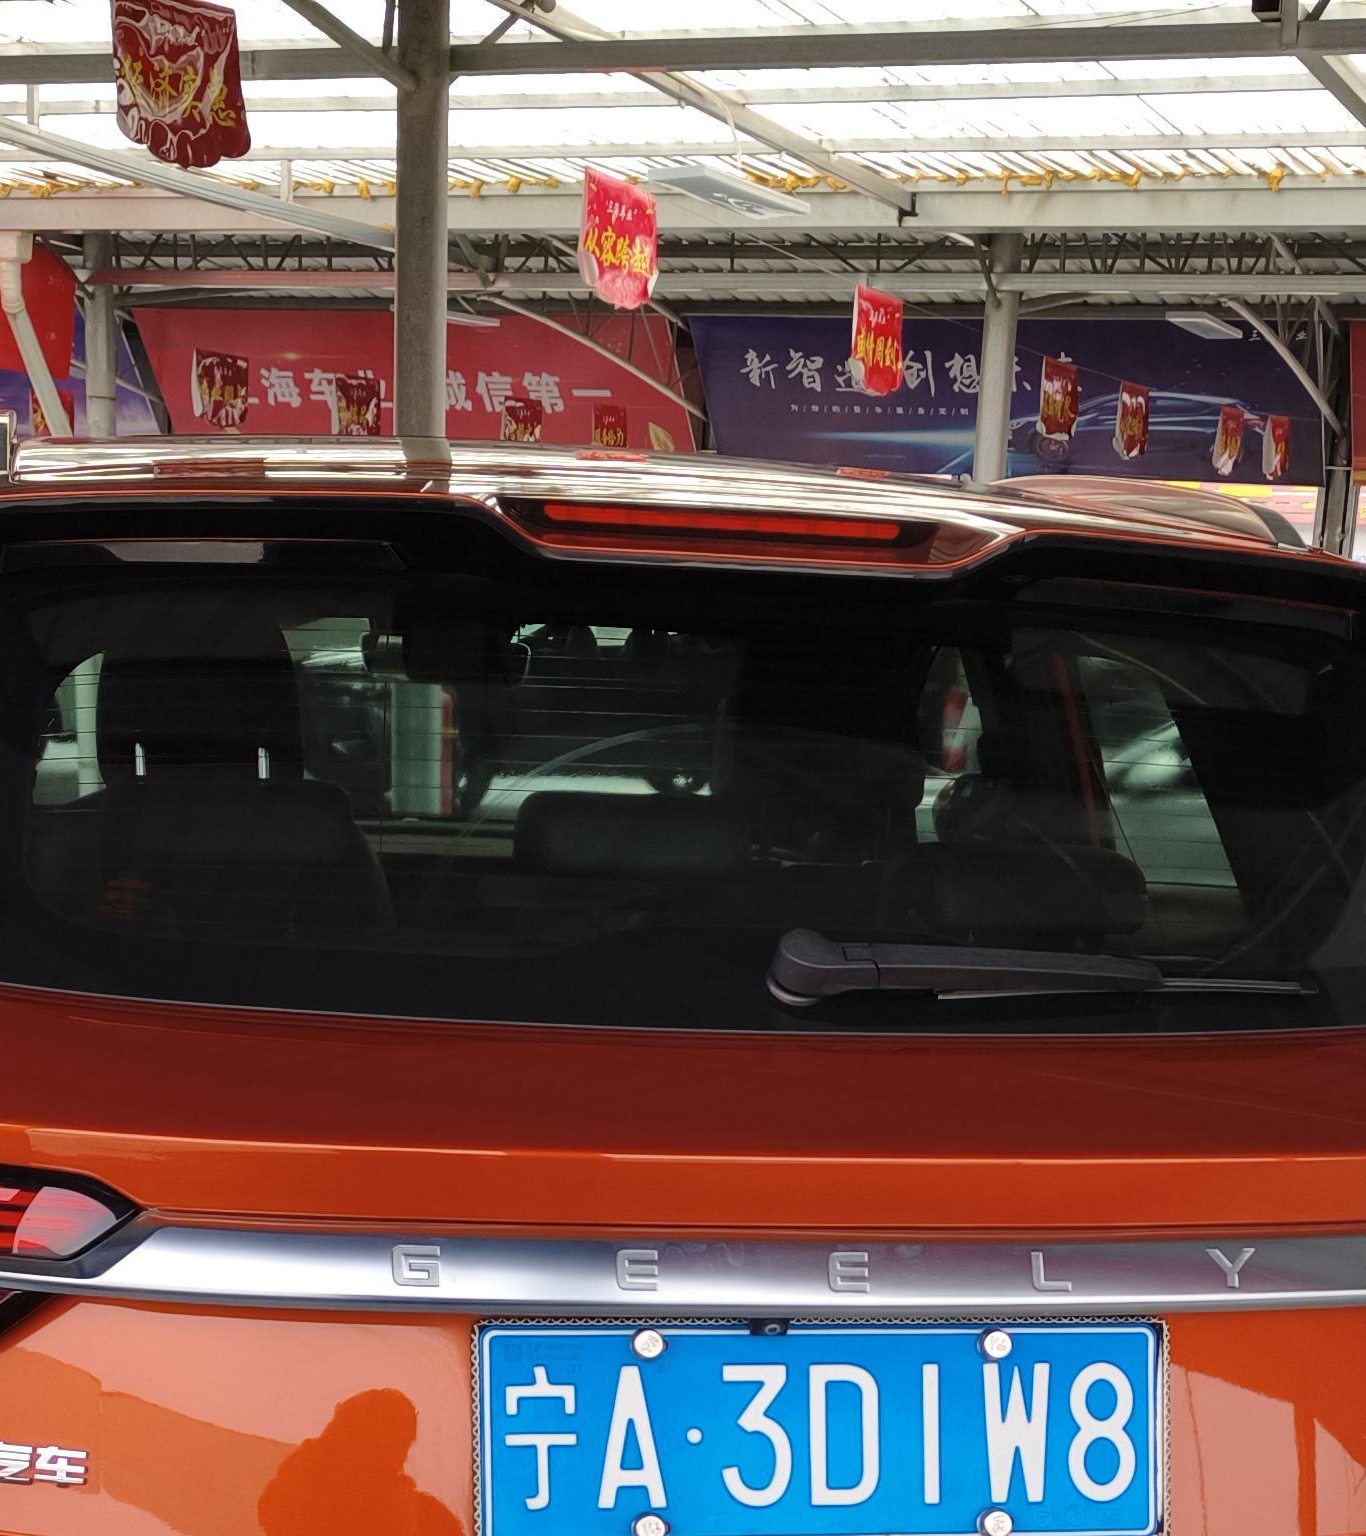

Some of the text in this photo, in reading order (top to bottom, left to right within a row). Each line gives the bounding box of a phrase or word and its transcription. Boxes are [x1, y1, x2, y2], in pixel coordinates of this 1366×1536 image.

[585, 225, 652, 278] 从容跨越
[391, 1244, 1257, 1293] GEELY
[504, 1362, 1137, 1510] 宁A·3D1W8
